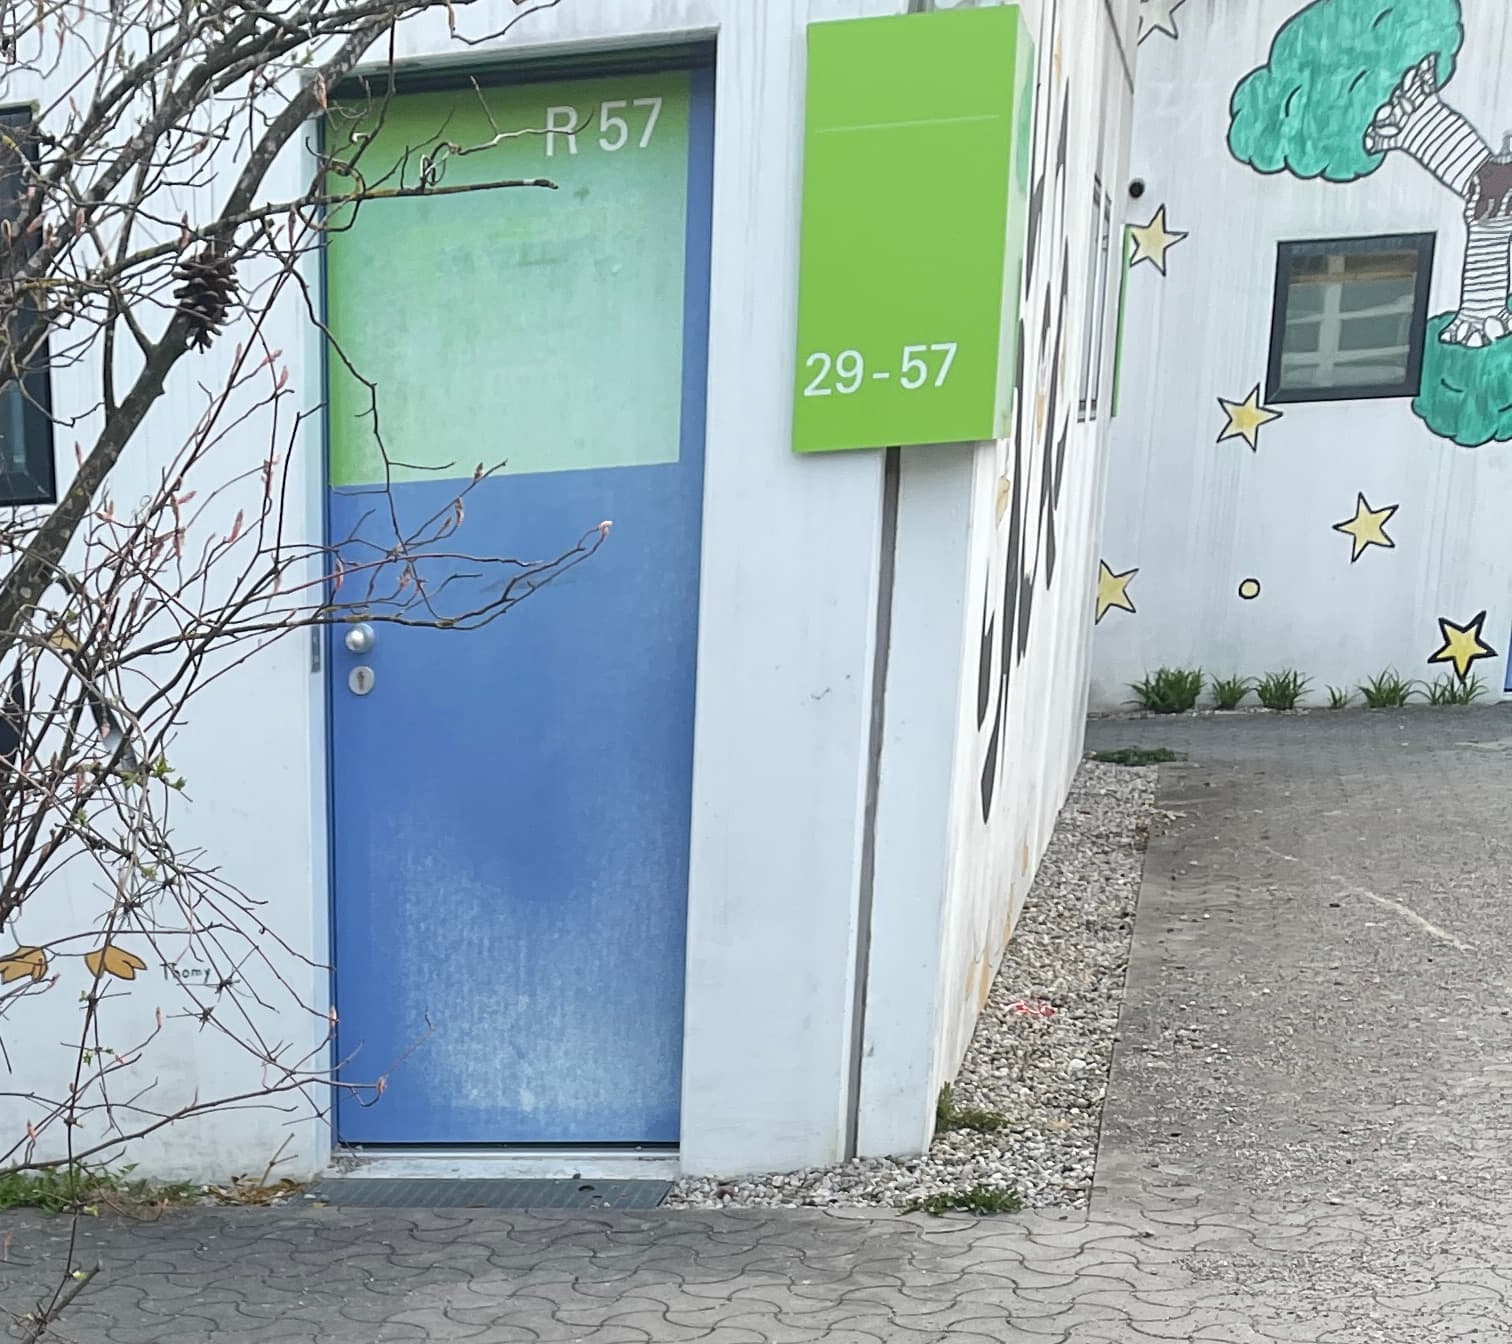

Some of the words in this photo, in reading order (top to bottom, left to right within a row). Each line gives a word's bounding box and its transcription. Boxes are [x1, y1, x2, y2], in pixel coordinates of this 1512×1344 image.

[546, 105, 577, 156] R
[598, 97, 662, 152] 57
[803, 350, 864, 397] 29
[900, 342, 958, 390] 57
